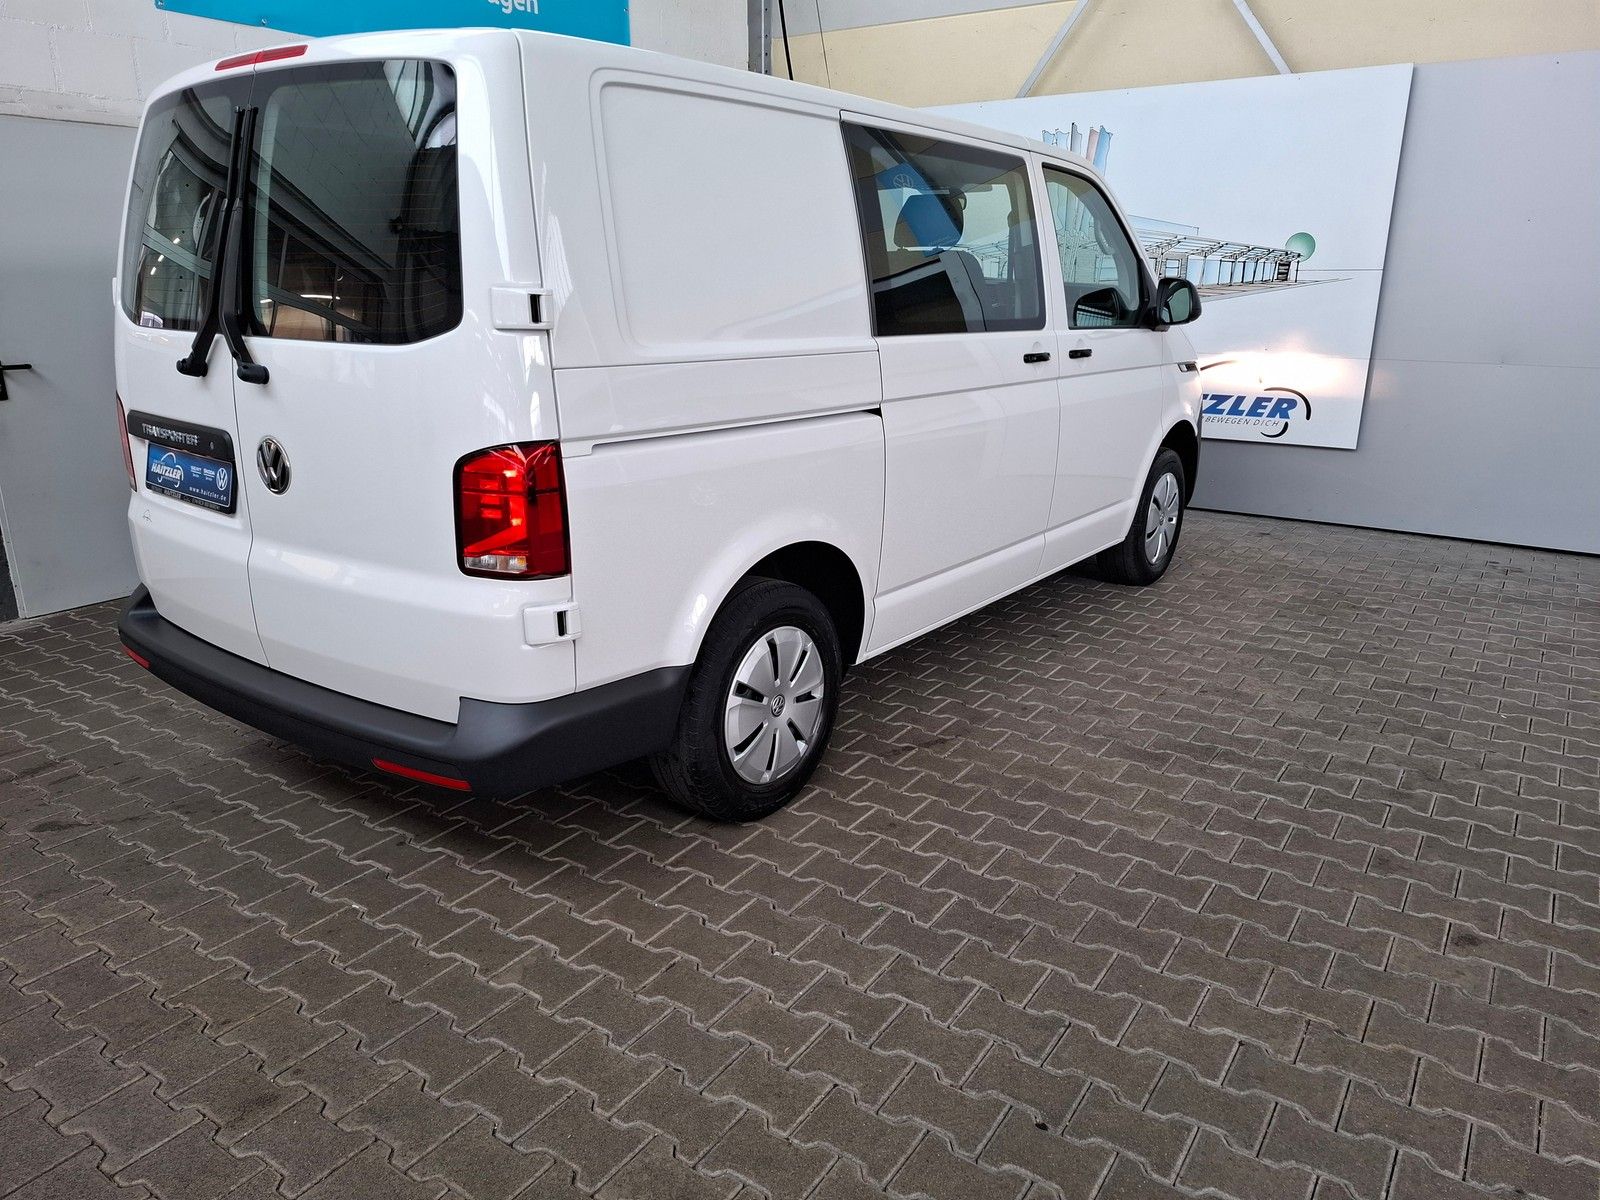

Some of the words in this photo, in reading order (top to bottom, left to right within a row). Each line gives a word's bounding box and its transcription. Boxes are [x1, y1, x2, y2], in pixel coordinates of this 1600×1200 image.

[1203, 393, 1298, 419] ZLER
[1204, 416, 1251, 425] BEWEGEN
[1253, 419, 1280, 427] DICH
[142, 423, 199, 446] TRANSPORTER
[151, 463, 182, 480] HAITZLER
[189, 485, 227, 502] www.haitzler.de
